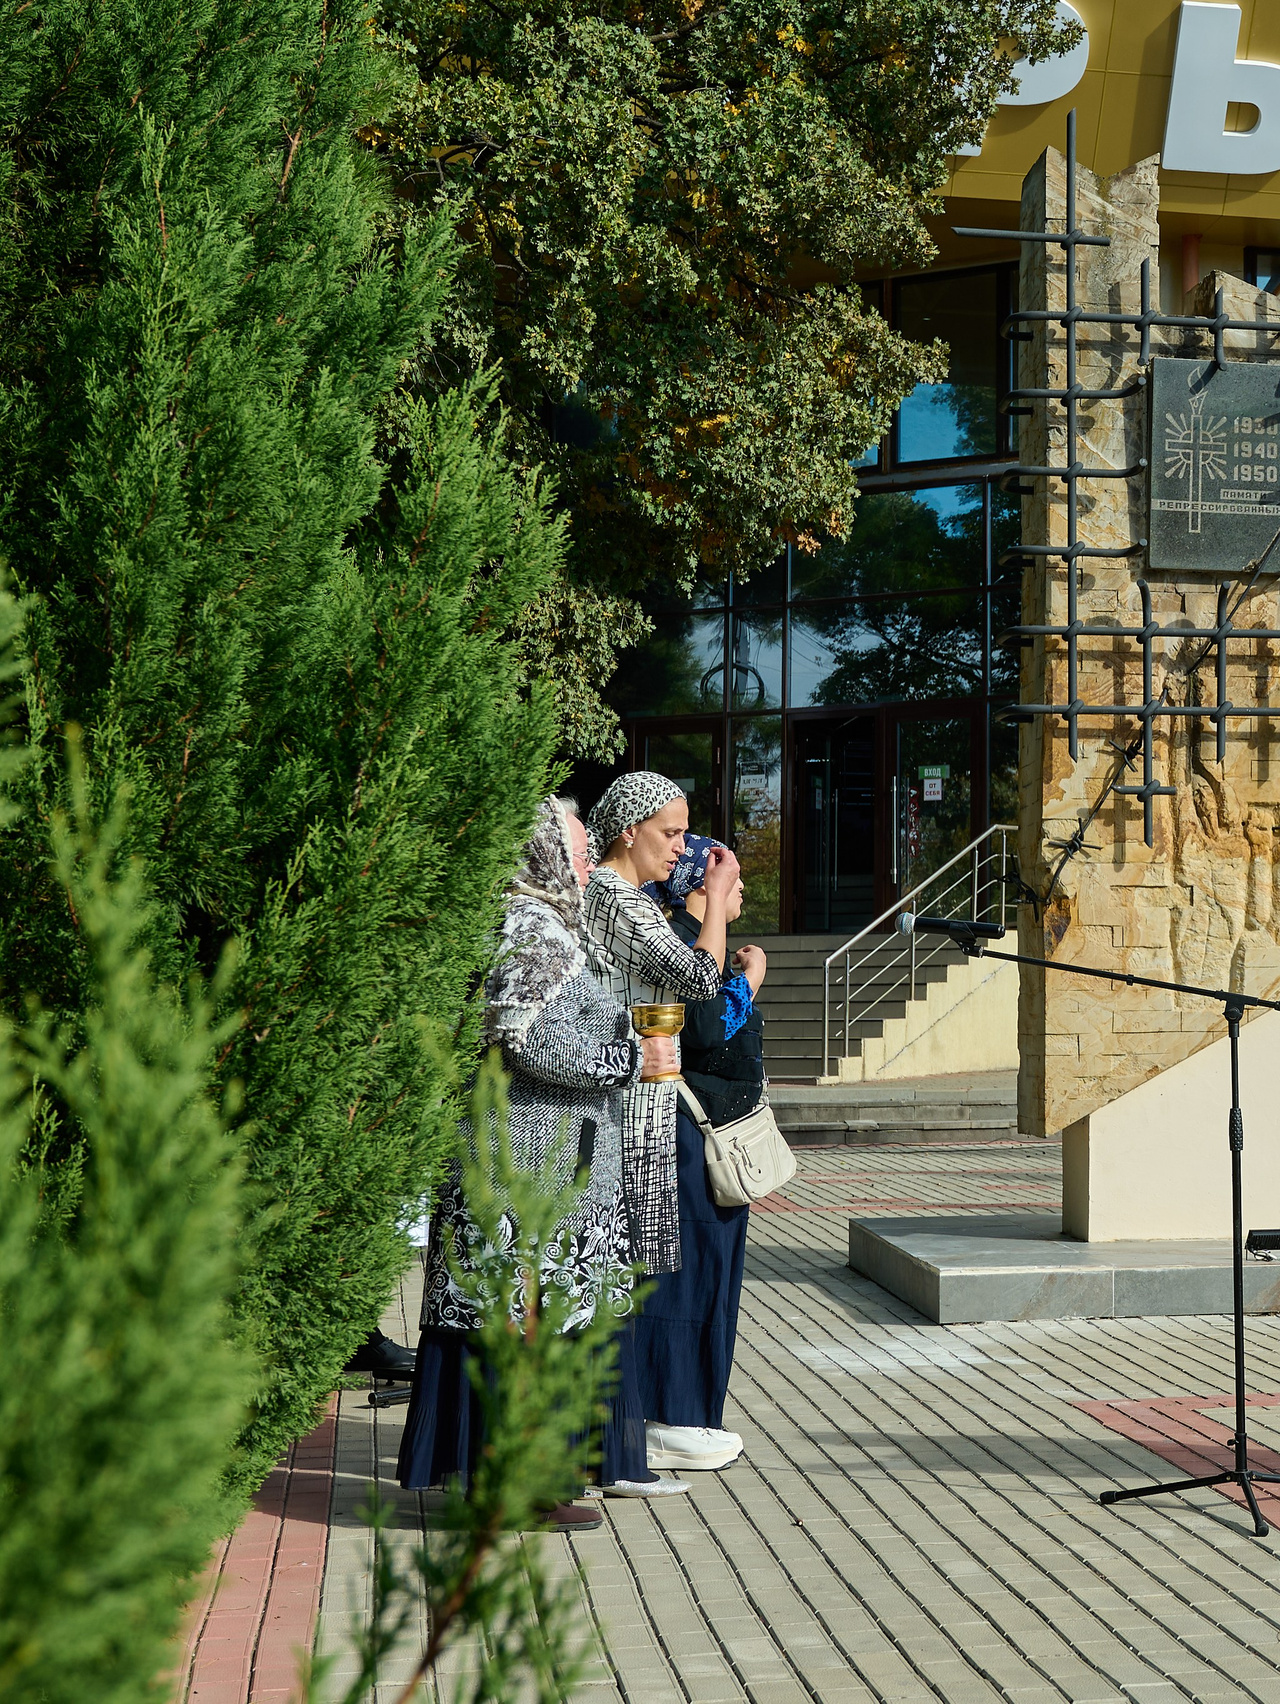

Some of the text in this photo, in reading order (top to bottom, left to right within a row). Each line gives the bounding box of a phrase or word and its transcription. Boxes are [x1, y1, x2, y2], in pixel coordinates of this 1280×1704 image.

[1233, 416, 1278, 435] 1930
[1233, 441, 1278, 459] 1940
[1233, 464, 1278, 483] 1950
[1222, 490, 1267, 500] ПАМЯТИ
[924, 767, 942, 778] ВХОД
